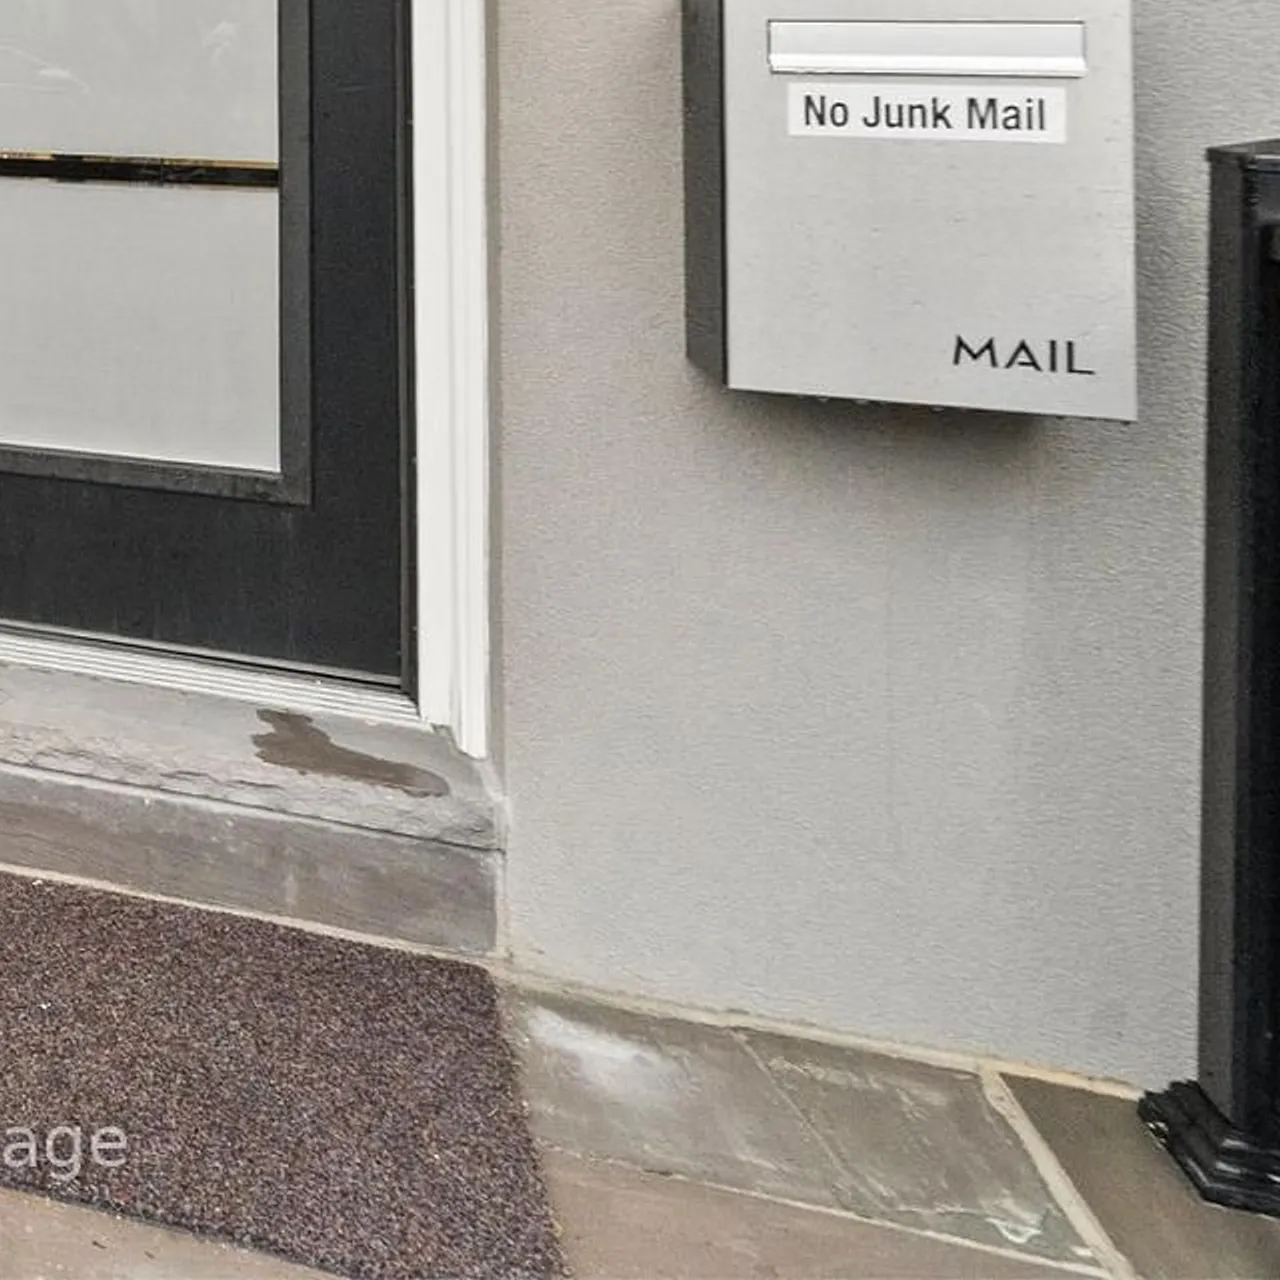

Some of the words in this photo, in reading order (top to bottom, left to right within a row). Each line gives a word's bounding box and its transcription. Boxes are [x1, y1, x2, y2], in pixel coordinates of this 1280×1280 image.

[803, 94, 849, 128] No
[862, 95, 953, 130] Junk
[967, 97, 1046, 131] Mail
[952, 334, 1096, 375] MAIL
